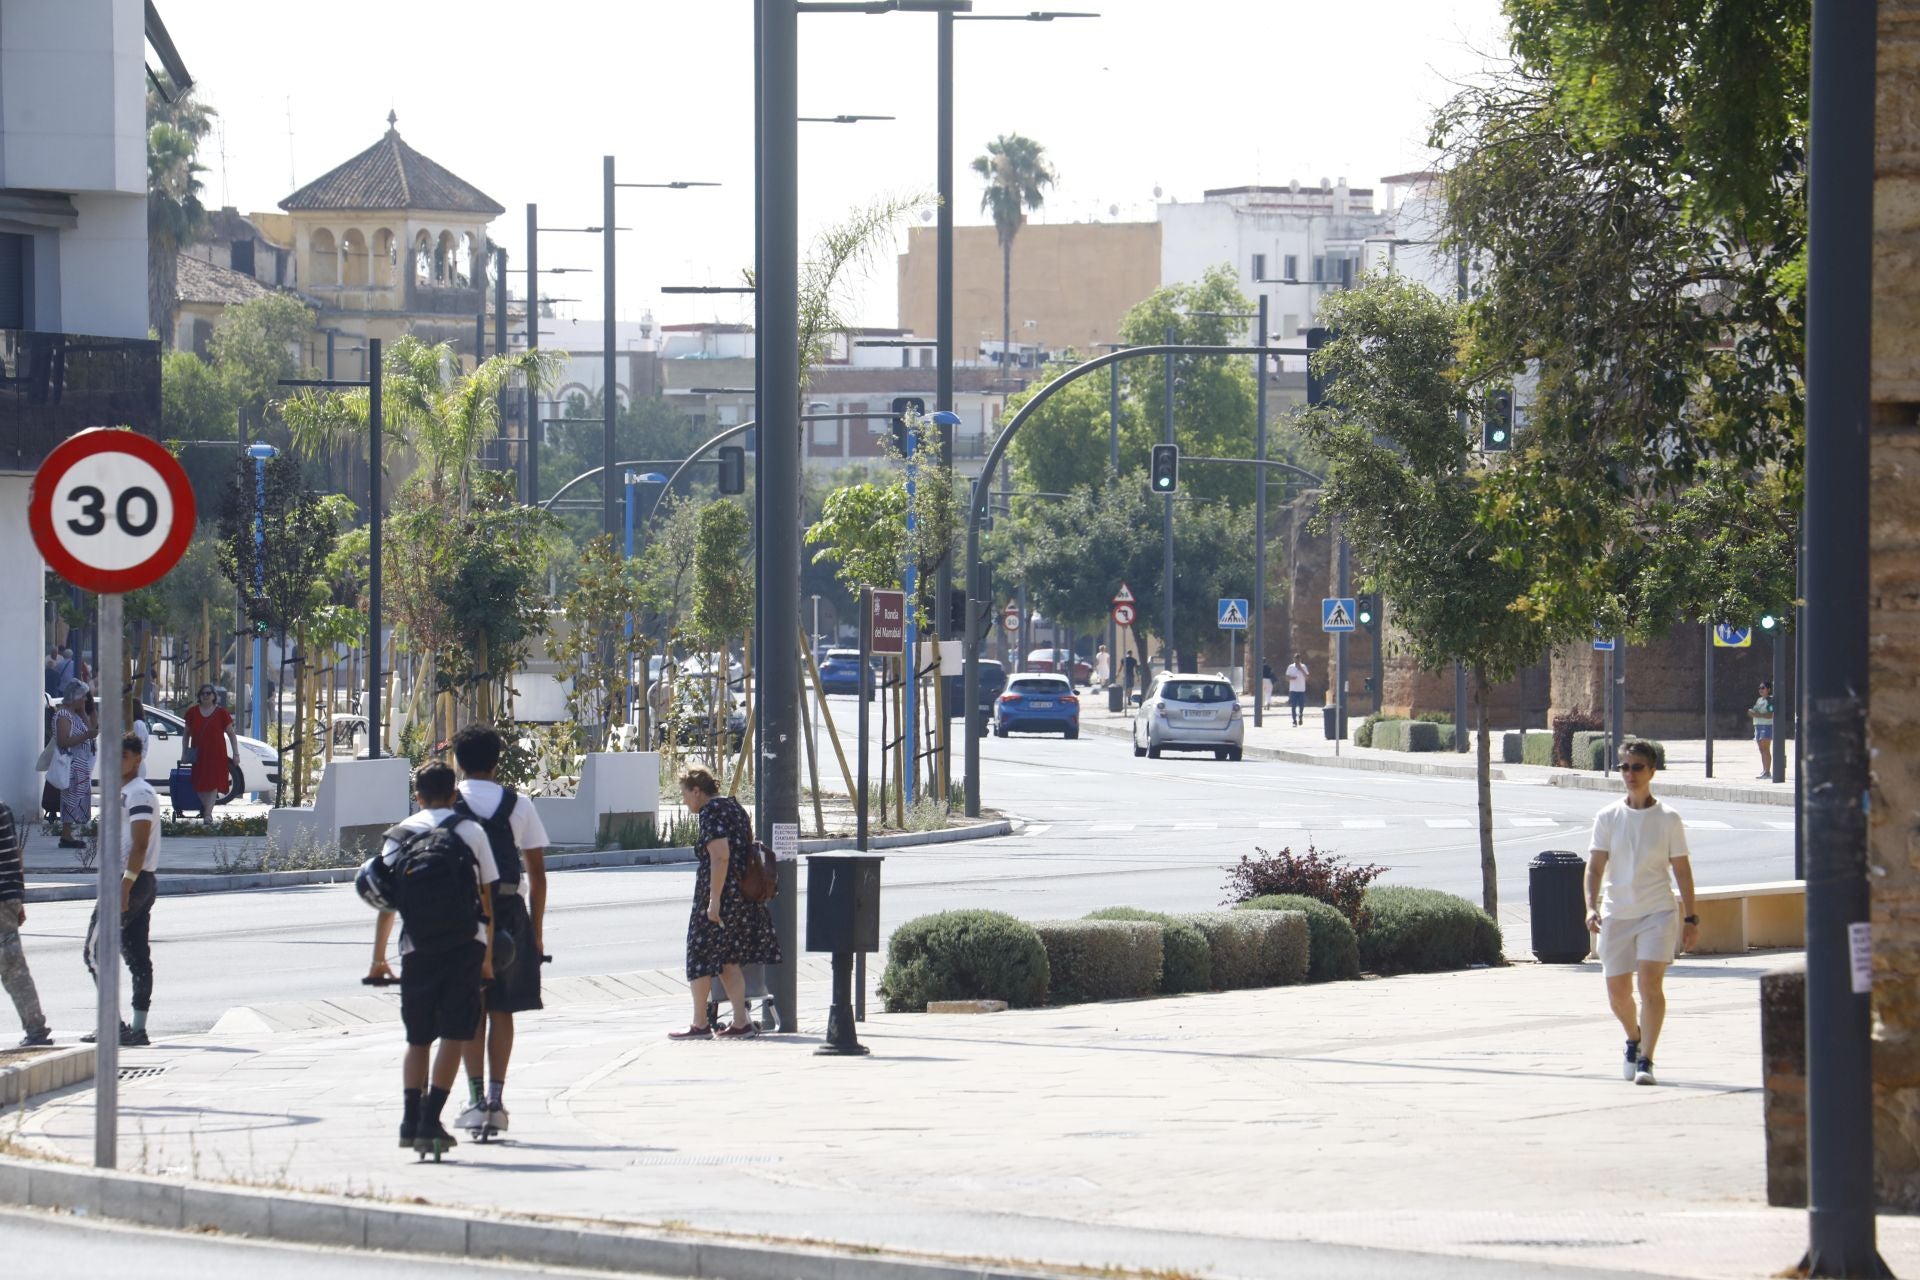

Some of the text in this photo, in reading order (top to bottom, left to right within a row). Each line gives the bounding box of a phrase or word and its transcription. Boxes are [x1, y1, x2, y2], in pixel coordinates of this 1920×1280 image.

[67, 485, 158, 536] 30
[884, 608, 898, 620] Ronda
[882, 627, 902, 638] Marrubial
